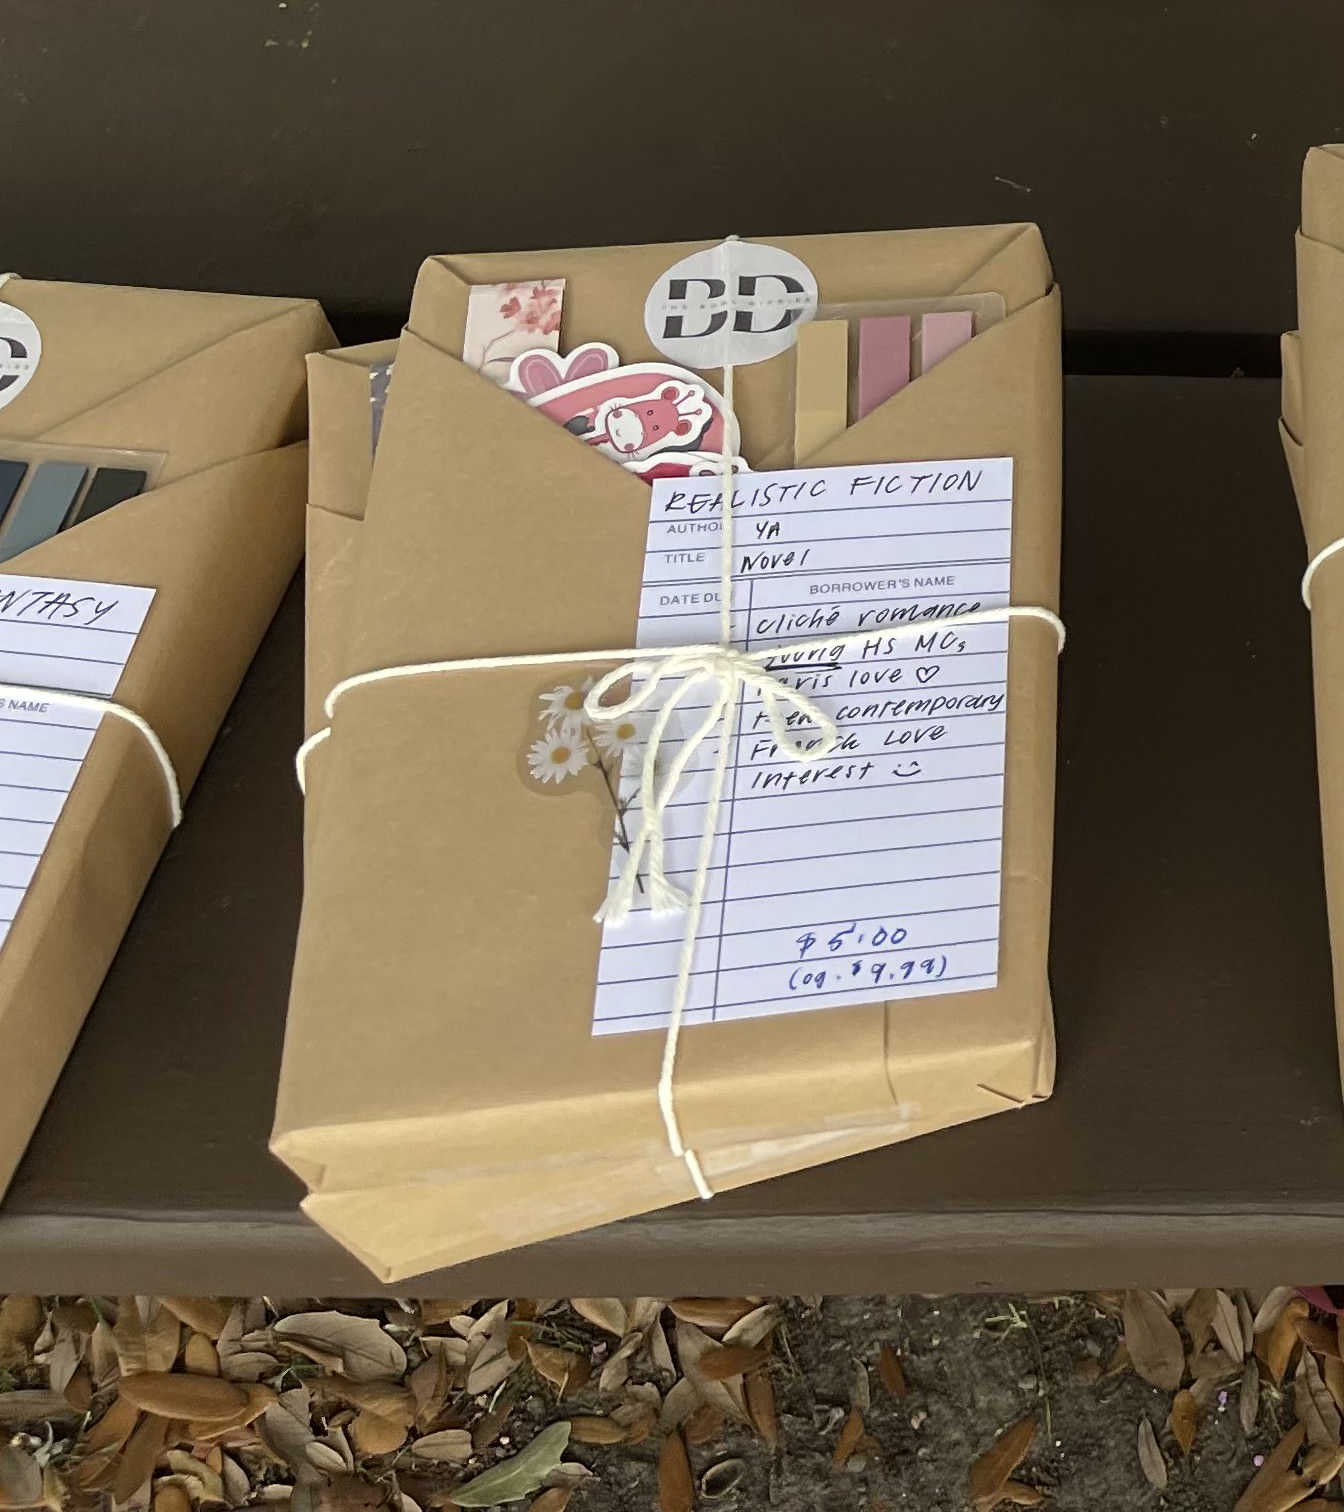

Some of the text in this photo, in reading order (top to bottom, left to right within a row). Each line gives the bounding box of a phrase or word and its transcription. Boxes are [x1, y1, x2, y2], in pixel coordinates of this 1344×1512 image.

[663, 275, 804, 338] BD
[665, 469, 984, 512] REALISTIC FICTION
[666, 522, 725, 534] AUTHO
[755, 521, 781, 539] YA
[664, 552, 705, 564] TITLE
[740, 549, 809, 573] Novel
[809, 575, 955, 594] BORROWER'S NAME
[660, 592, 724, 606] DATE DU
[757, 602, 981, 634] cliché romance
[863, 637, 897, 658] HS
[849, 667, 902, 688] love
[836, 693, 1005, 720] contemporary
[884, 725, 948, 746] Love
[752, 762, 875, 789] Interest
